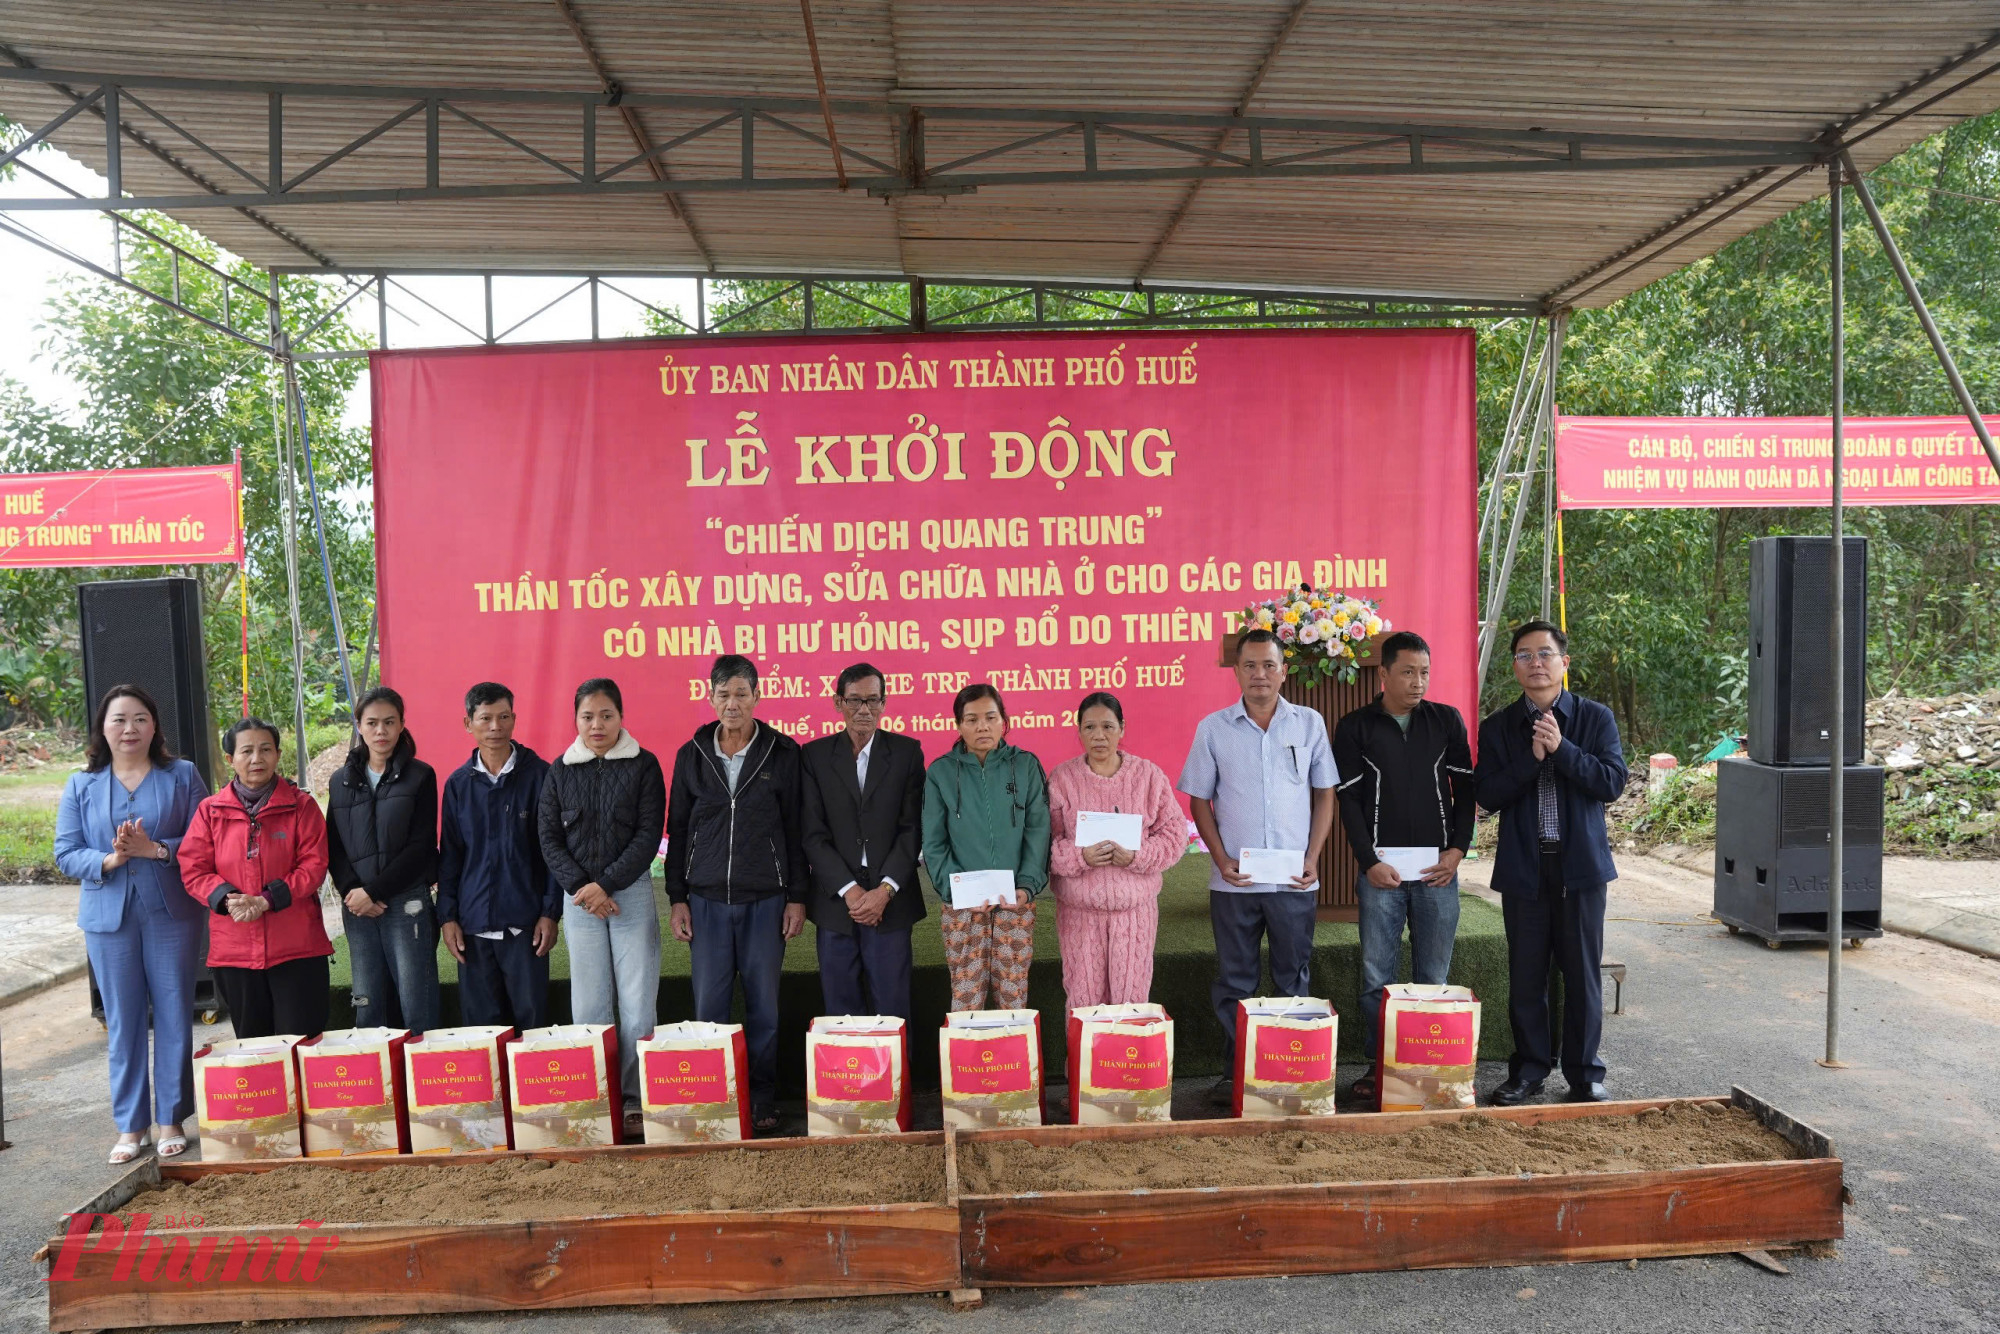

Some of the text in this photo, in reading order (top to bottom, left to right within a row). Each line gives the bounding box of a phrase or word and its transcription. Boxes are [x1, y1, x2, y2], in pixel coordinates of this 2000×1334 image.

[659, 341, 1198, 396] ỦY BAN NHÂN DÂN THÀNH PHỐ HUẾ
[685, 410, 1177, 491] LỄ KHỞI ĐỘNG
[1628, 434, 1665, 459] CÁN
[1669, 434, 1698, 463] BỘ,
[1703, 432, 1755, 459] CHIẾN
[1759, 434, 1778, 458] SĨ
[1842, 433, 1891, 458] ĐOÀN
[1895, 437, 1907, 457] 6
[1911, 430, 1966, 459] QUYẾT
[1603, 465, 1661, 493] NHIỆM
[1665, 469, 1688, 493] VỤ
[1692, 464, 1740, 489] HÀNH
[1744, 464, 1792, 491] QUÂN
[1796, 464, 1821, 489] DÃ
[1882, 463, 1920, 488] LÀM
[1924, 463, 1973, 487] CÔNG
[4, 487, 45, 515] HUẾ
[108, 515, 162, 545] THẦN
[166, 514, 205, 543] TỐC
[833, 520, 909, 558] DỊCH
[920, 517, 1029, 553] QUANG
[473, 553, 1388, 613] THẦN TỐC XÂY DỰNG, SỬA CHỮA NHÀ Ở CHO CÁC GIA ĐÌNH
[603, 621, 646, 659] CÓ
[656, 619, 725, 657] NHÀ
[734, 624, 767, 661] BỊ
[777, 619, 824, 654] HƯ
[830, 611, 930, 653] HỎNG,
[941, 617, 1006, 655] SỤP
[1014, 603, 1060, 647] ĐỔ
[1069, 614, 1112, 645] DO
[1121, 606, 1213, 644] THIÊN
[757, 663, 811, 699] IỂM:
[883, 673, 915, 696] HE
[986, 663, 1072, 692] THÀNH
[1078, 655, 1128, 689] PHỐ
[1135, 654, 1186, 688] HUẾ
[768, 714, 815, 739] Huế,
[880, 715, 906, 733] 06
[911, 712, 958, 732] thán
[1009, 710, 1055, 729] năm
[1403, 1036, 1431, 1045] THÀNH
[957, 1064, 984, 1073] THÀNH
[1099, 1059, 1127, 1069] THÀNH
[1264, 1052, 1291, 1062] THÀNH
[313, 1080, 339, 1089] THÀNH
[422, 1076, 448, 1085] THÀNH
[524, 1075, 551, 1085] THÀNH
[654, 1075, 681, 1084] THÀNH
[822, 1070, 848, 1079] THÀNH
[212, 1092, 239, 1101] THÀNH
